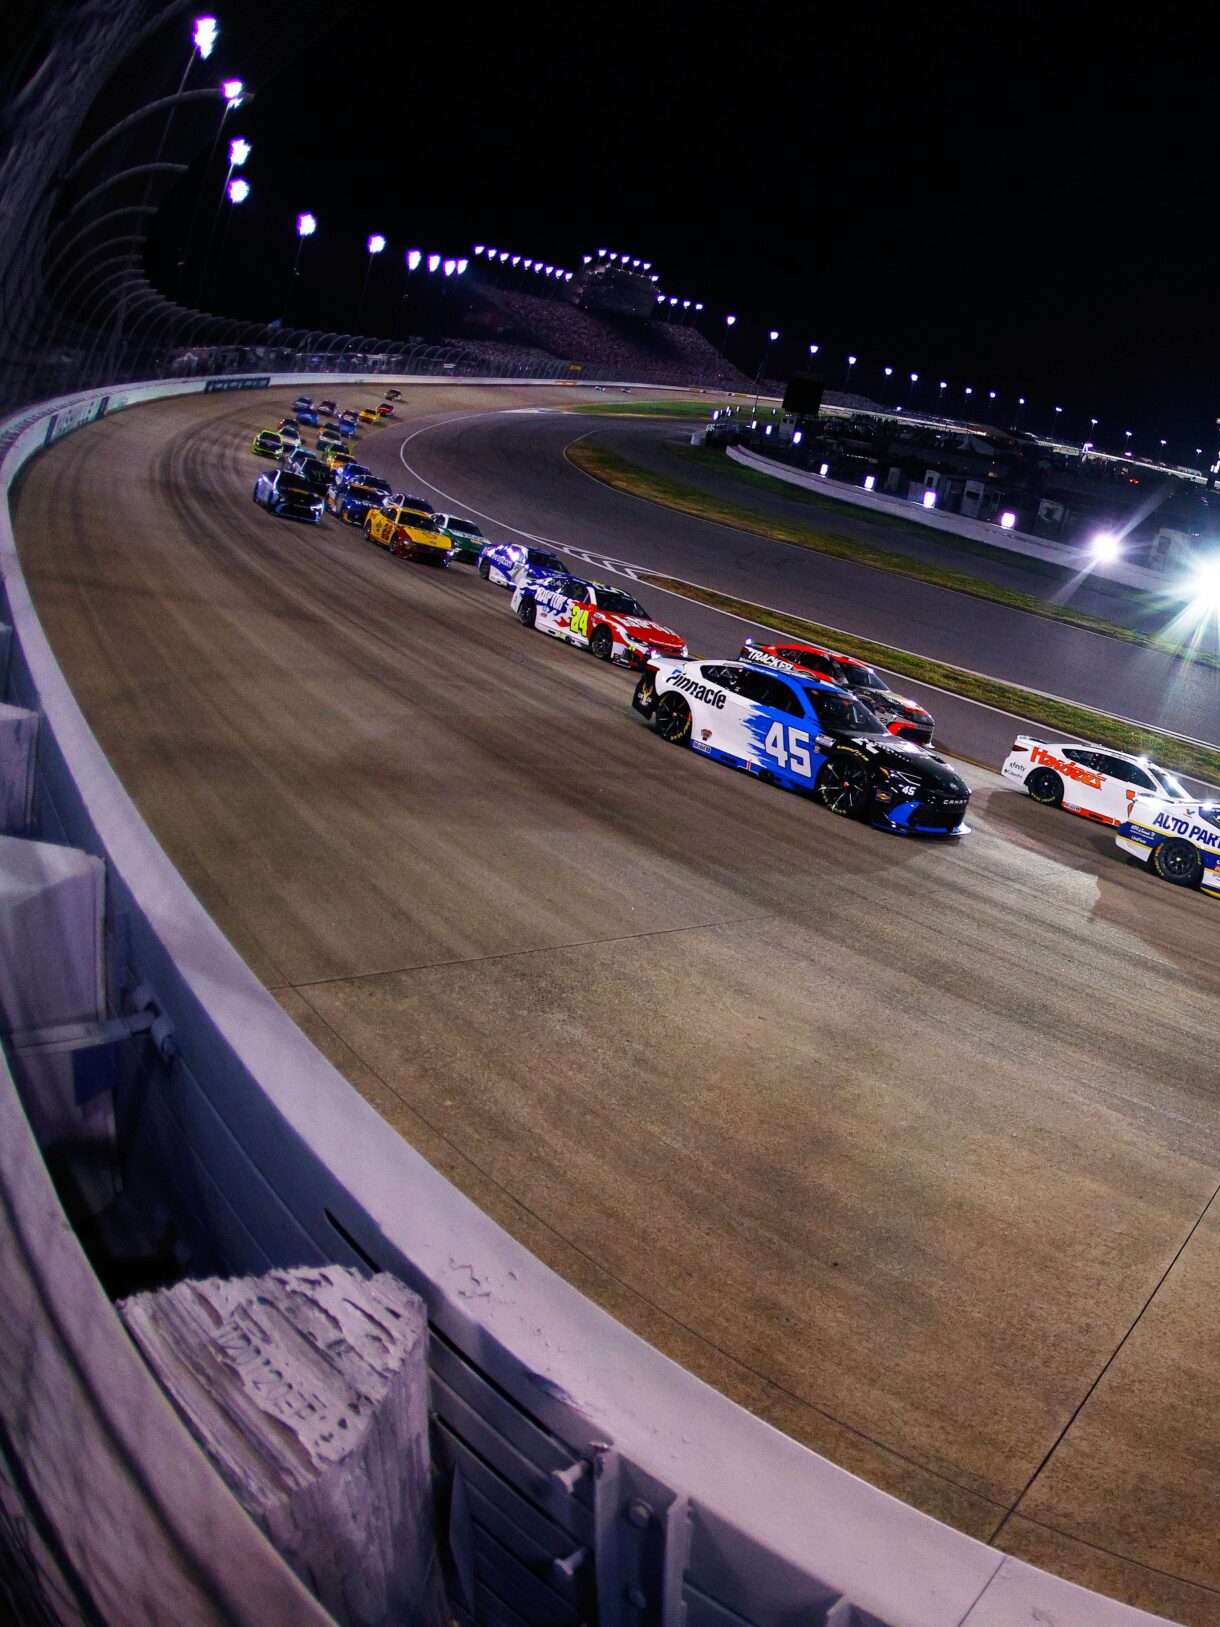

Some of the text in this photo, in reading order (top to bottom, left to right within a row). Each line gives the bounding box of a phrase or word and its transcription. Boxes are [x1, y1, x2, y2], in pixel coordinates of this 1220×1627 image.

[570, 605, 590, 637] 24
[666, 669, 727, 709] Pinnacle
[765, 721, 812, 778] 45
[901, 785, 917, 796] 45
[1152, 812, 1189, 835] AUTO
